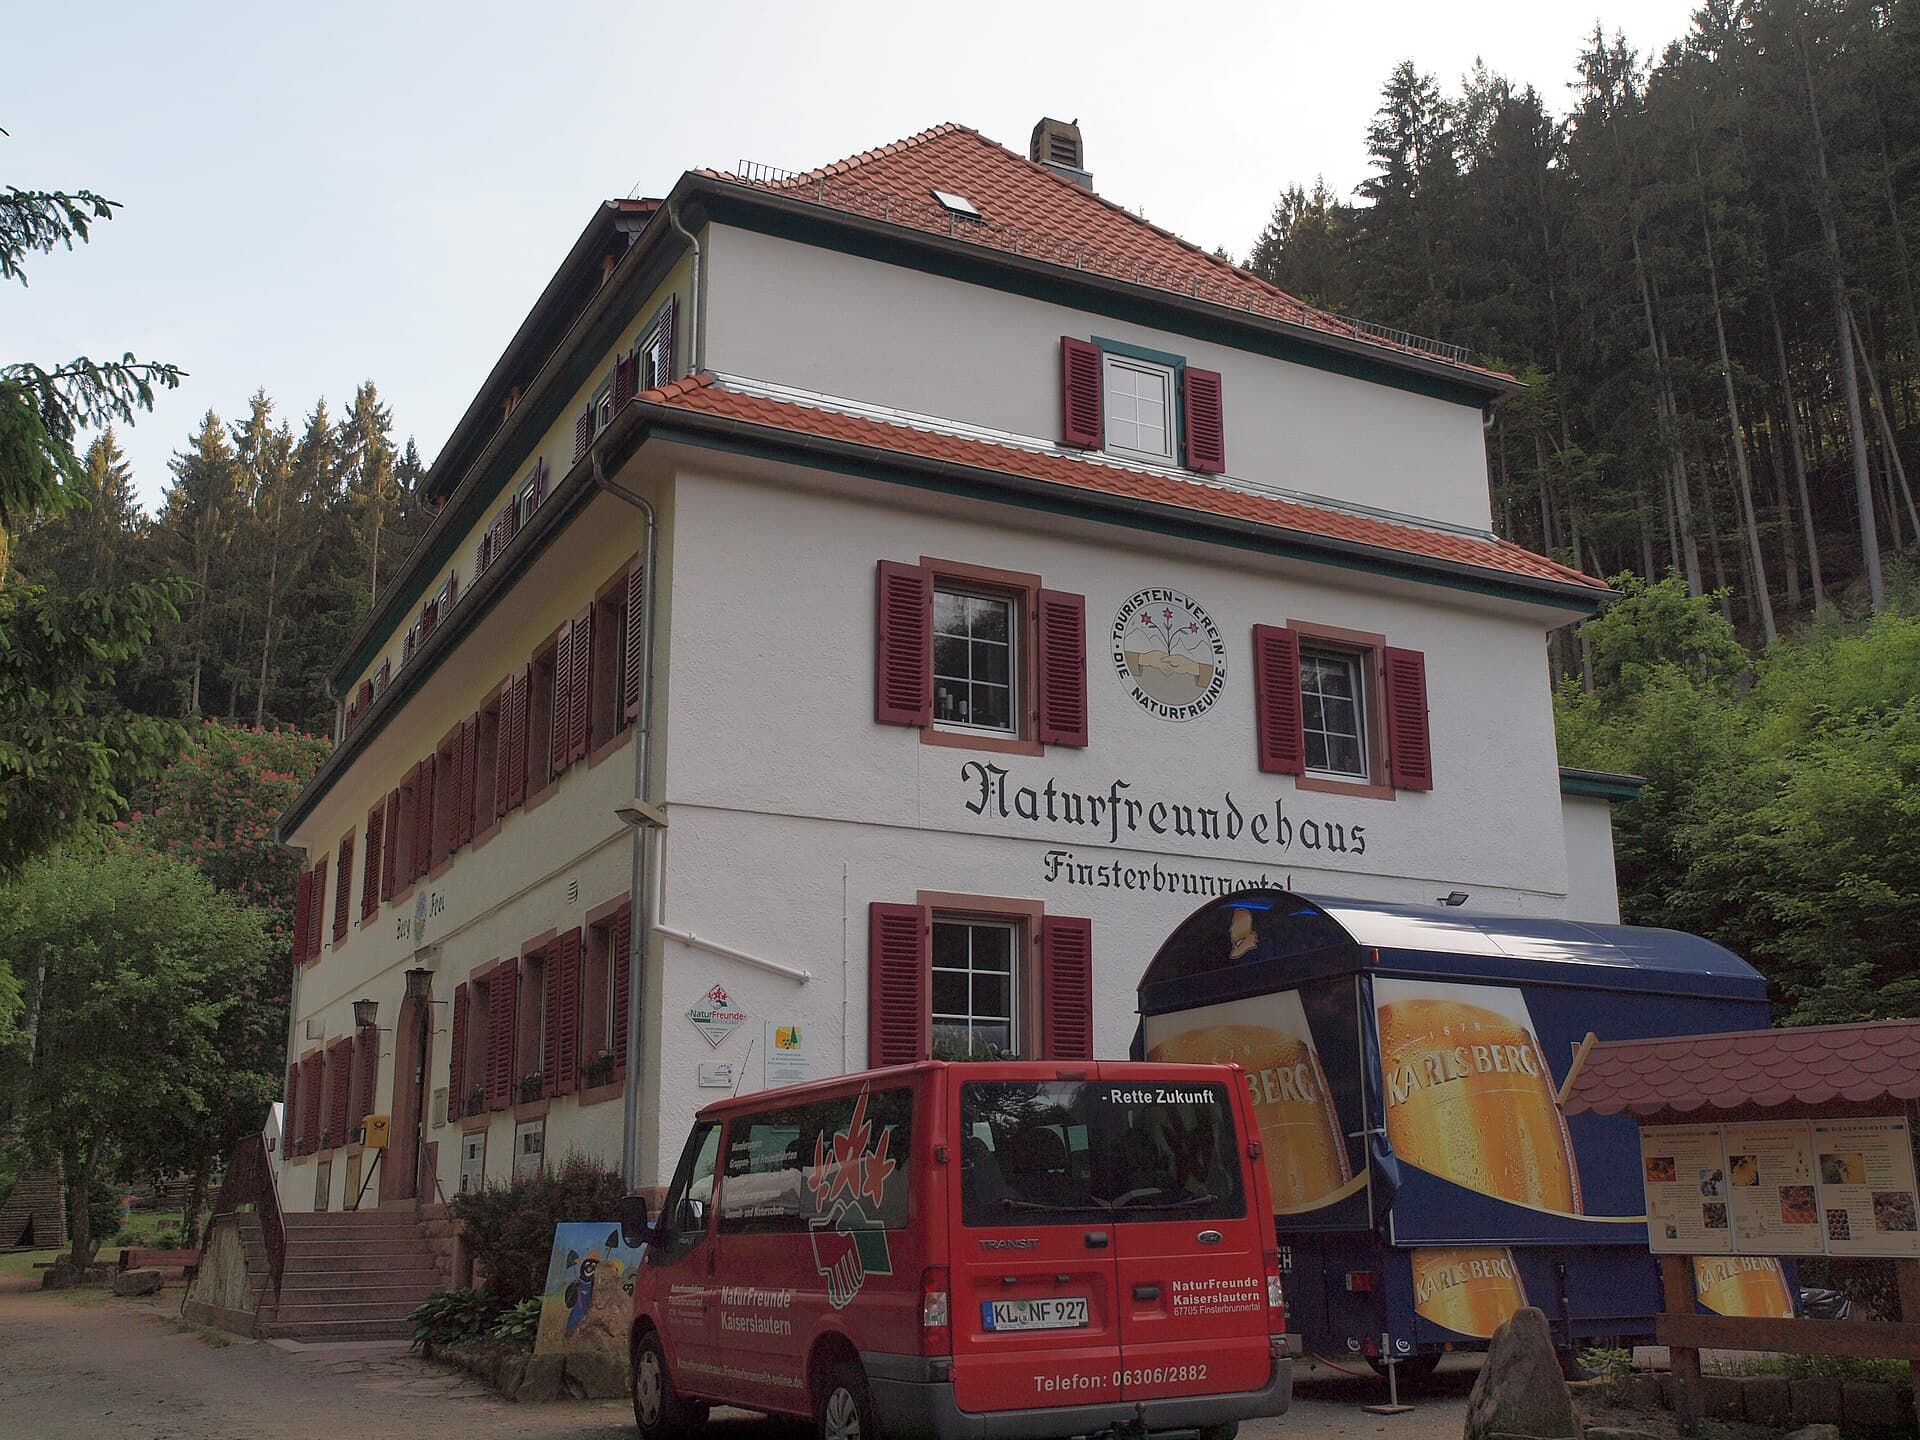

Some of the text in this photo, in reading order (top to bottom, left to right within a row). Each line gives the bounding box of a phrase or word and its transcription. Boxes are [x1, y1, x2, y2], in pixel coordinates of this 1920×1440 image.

[1113, 590, 1224, 655] TOURISTEN-VEREIN
[1113, 653, 1225, 719] DIE NATURFREUNDE
[961, 760, 1367, 855] Naturfreundehaus
[690, 1009, 744, 1020] NaturFreunde
[1386, 1044, 1540, 1108] KARLSBERG
[1110, 1089, 1153, 1104] Rette
[1155, 1089, 1215, 1104] Zukunft
[978, 1238, 1039, 1249] TRANSIT
[1172, 1277, 1259, 1292] NaturFreunde
[1417, 1258, 1512, 1305] KARLSBERG
[721, 1286, 791, 1308] NaturFreunde
[1173, 1291, 1260, 1306] Kaiserslautern
[994, 1304, 1017, 1323] KL
[1028, 1302, 1049, 1321] NF
[1054, 1301, 1085, 1320] 927
[1174, 1303, 1261, 1316] 67705 Finsterbrunnertal
[721, 1312, 791, 1335] Kaiserslautern
[1034, 1364, 1208, 1392] Telefon: 06306/2882
